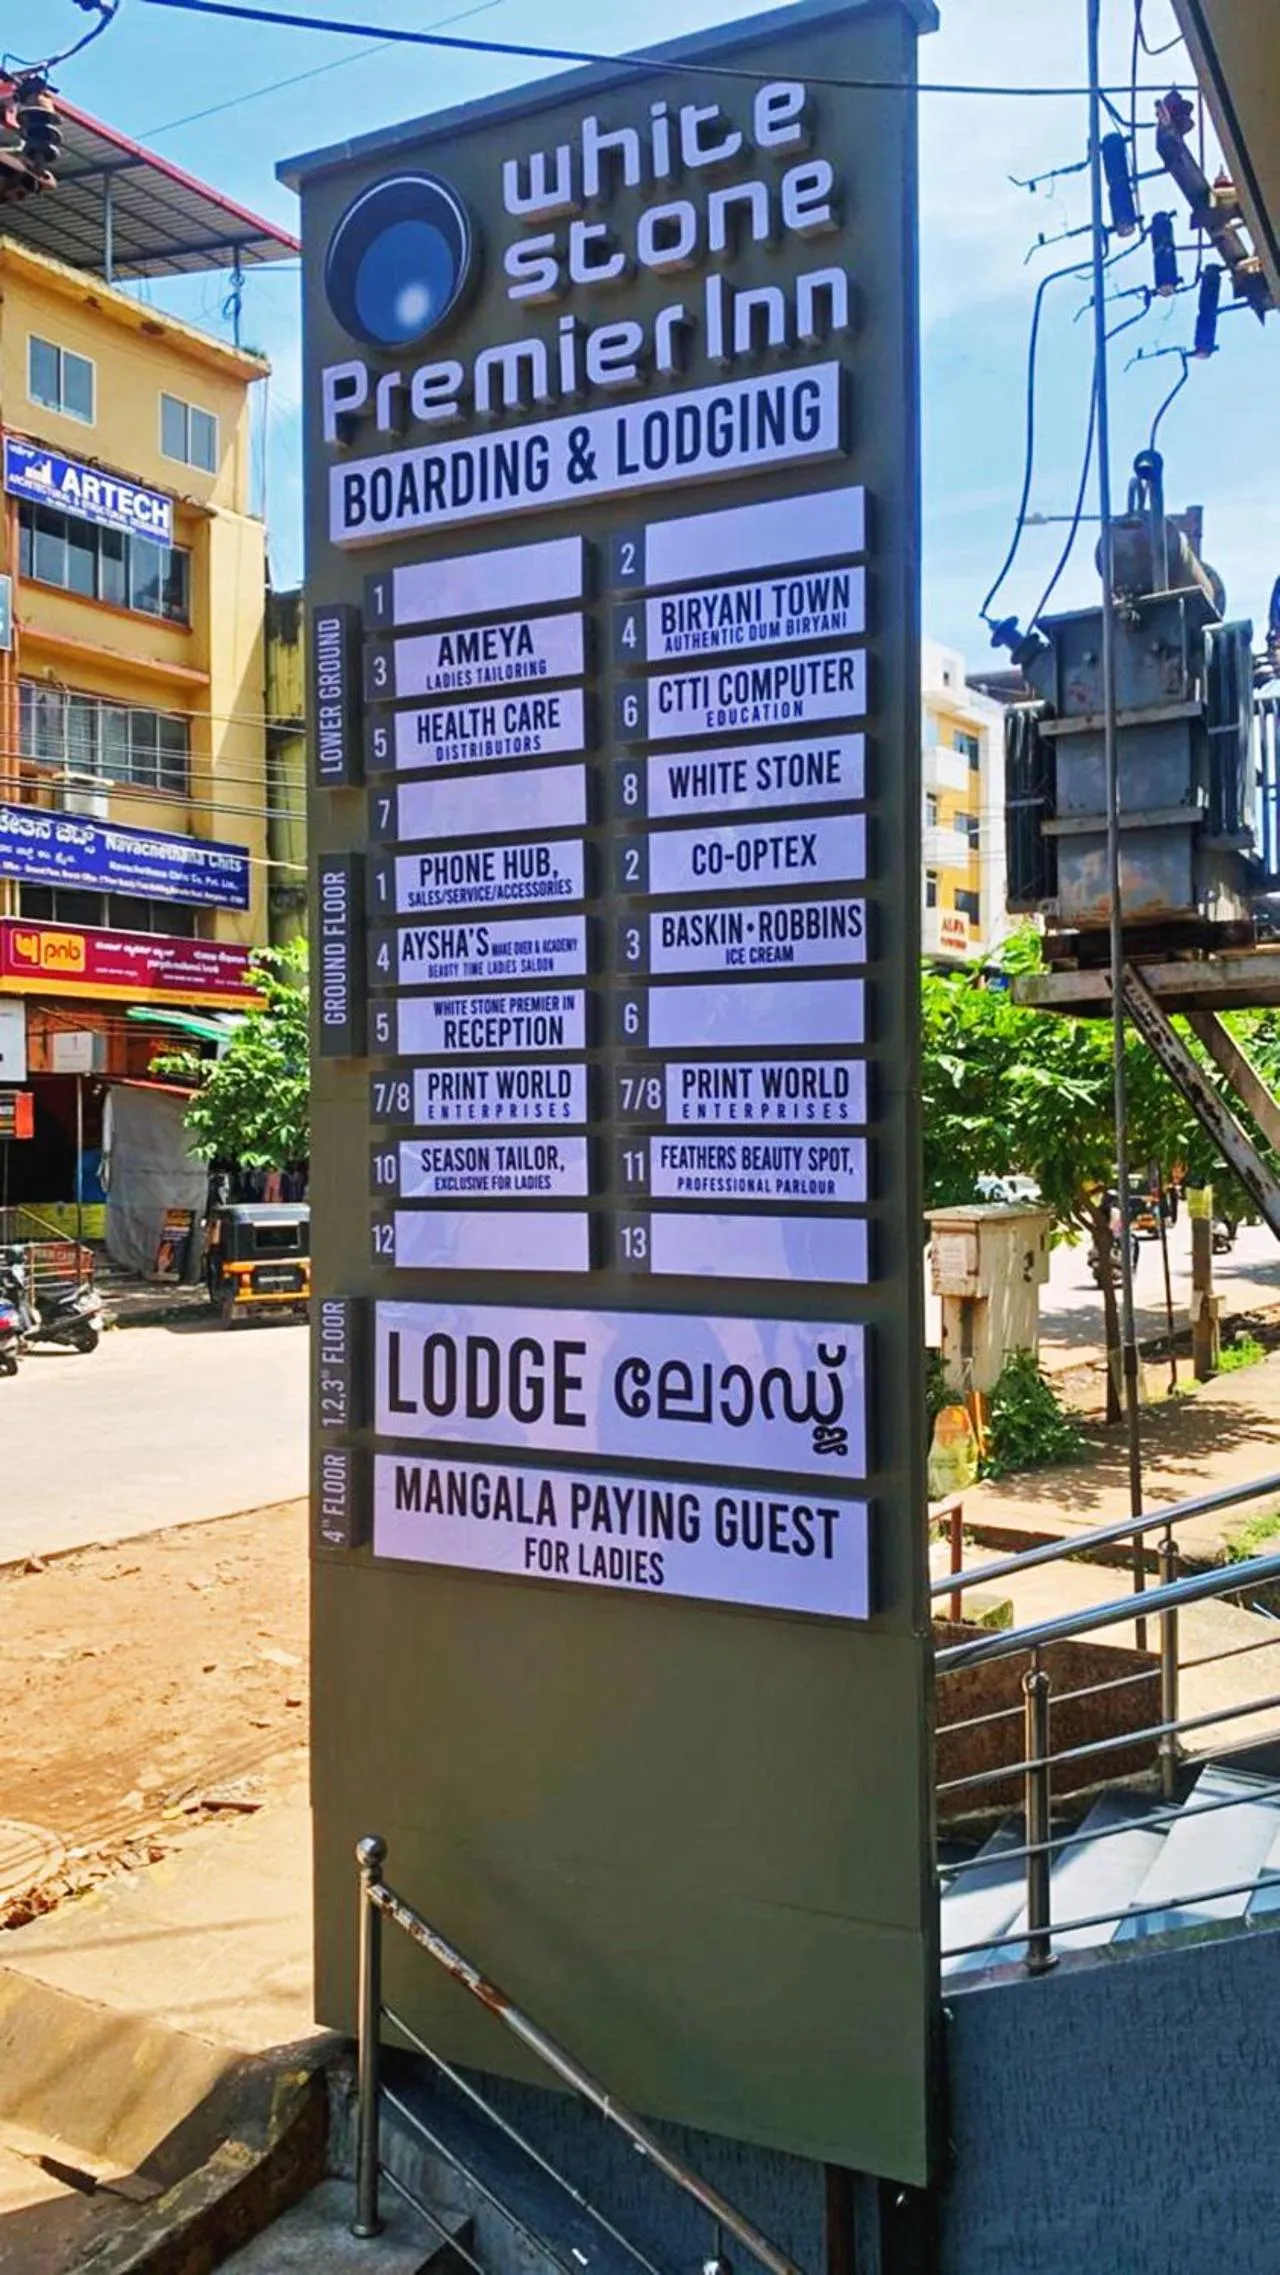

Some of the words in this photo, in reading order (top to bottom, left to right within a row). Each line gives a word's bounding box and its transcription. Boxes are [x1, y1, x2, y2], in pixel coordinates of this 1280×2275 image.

[503, 81, 807, 217] white
[504, 159, 835, 301] stone
[322, 304, 685, 444] Premier
[705, 267, 849, 361] Inn
[343, 434, 549, 527] BOARDING
[566, 425, 598, 485] &
[616, 379, 821, 476] LODGING
[61, 466, 170, 529] ARTECH
[620, 542, 636, 575] 2
[373, 585, 384, 615] 1
[661, 588, 762, 635] BIRYANI
[771, 575, 850, 619] TOWN
[437, 624, 535, 667] AMEYA
[621, 616, 637, 648] 4
[665, 625, 744, 653] AUTHENTIC
[749, 621, 781, 640] DUM
[786, 612, 847, 637] BIRYANI
[317, 618, 342, 700] GROUND
[373, 656, 387, 686] 3
[426, 668, 472, 690] LADIES
[476, 659, 547, 684] TAILORING
[658, 675, 709, 713] CTTI
[718, 657, 854, 706] COMPUTER
[417, 706, 496, 745] HEALTH
[503, 698, 560, 733] CARE
[623, 695, 638, 728] 6
[706, 699, 804, 728] EDUCATION
[319, 705, 343, 774] LOWER
[373, 728, 387, 758] 5
[436, 735, 541, 762] DISTRIBUTORS
[623, 773, 638, 805] 8
[668, 760, 748, 799] WHITE
[756, 750, 841, 791] STONE
[378, 799, 390, 829] 7
[420, 852, 496, 887] PHONE
[503, 847, 559, 880] HUB,
[624, 849, 639, 880] 2
[692, 834, 817, 876] CO-OPTEX
[323, 871, 346, 936] FLOOR
[376, 872, 386, 901] 1
[44, 940, 81, 964] pnb
[376, 943, 390, 972] 4
[401, 927, 489, 962] AYSHA'S
[626, 929, 640, 960] 3
[725, 948, 746, 966] ICE
[749, 945, 794, 965] CREAM
[323, 943, 347, 1025] GROUND
[487, 959, 517, 975] LADIES
[433, 999, 468, 1017] WHITE
[471, 997, 506, 1016] STONE
[509, 996, 559, 1014] PREMIER
[563, 995, 576, 1011] IN
[624, 1002, 639, 1034] 6
[376, 1013, 390, 1042] 5
[444, 1016, 563, 1049] RECEPTION
[373, 1082, 410, 1113] 7/8
[428, 1071, 489, 1101] PRINT
[496, 1069, 571, 1099] WORLD
[620, 1078, 661, 1111] 7/8
[682, 1068, 752, 1099] PRINT
[761, 1067, 849, 1099] WORLD
[428, 1103, 570, 1120] ENTERPRISES
[682, 1103, 848, 1120] ENTERPRISES
[373, 1155, 396, 1184] 10
[421, 1147, 490, 1172] SEASON
[495, 1145, 565, 1173] TAILOR,
[623, 1151, 644, 1182] 11
[661, 1145, 737, 1170] FEATHERS
[742, 1146, 803, 1171] BEAUTY
[808, 1147, 854, 1175] SPOT,
[435, 1176, 489, 1191] EXCLUSIVE
[492, 1175, 511, 1190] FOR
[514, 1175, 551, 1190] LADIES
[677, 1177, 771, 1193] PROFESSIONAL
[776, 1178, 835, 1195] PARLOUR
[372, 1224, 394, 1254] 12
[621, 1227, 647, 1258] 13
[322, 1302, 345, 1364] FLOOR
[388, 1331, 587, 1427] LODGE
[321, 1369, 346, 1427] 1,2,3
[322, 1454, 346, 1516] FLOOR
[395, 1465, 558, 1527] MANGALA
[571, 1482, 700, 1544] PAYING
[714, 1497, 840, 1560] GUEST
[525, 1537, 569, 1574] FOR
[578, 1543, 665, 1586] LADIES
